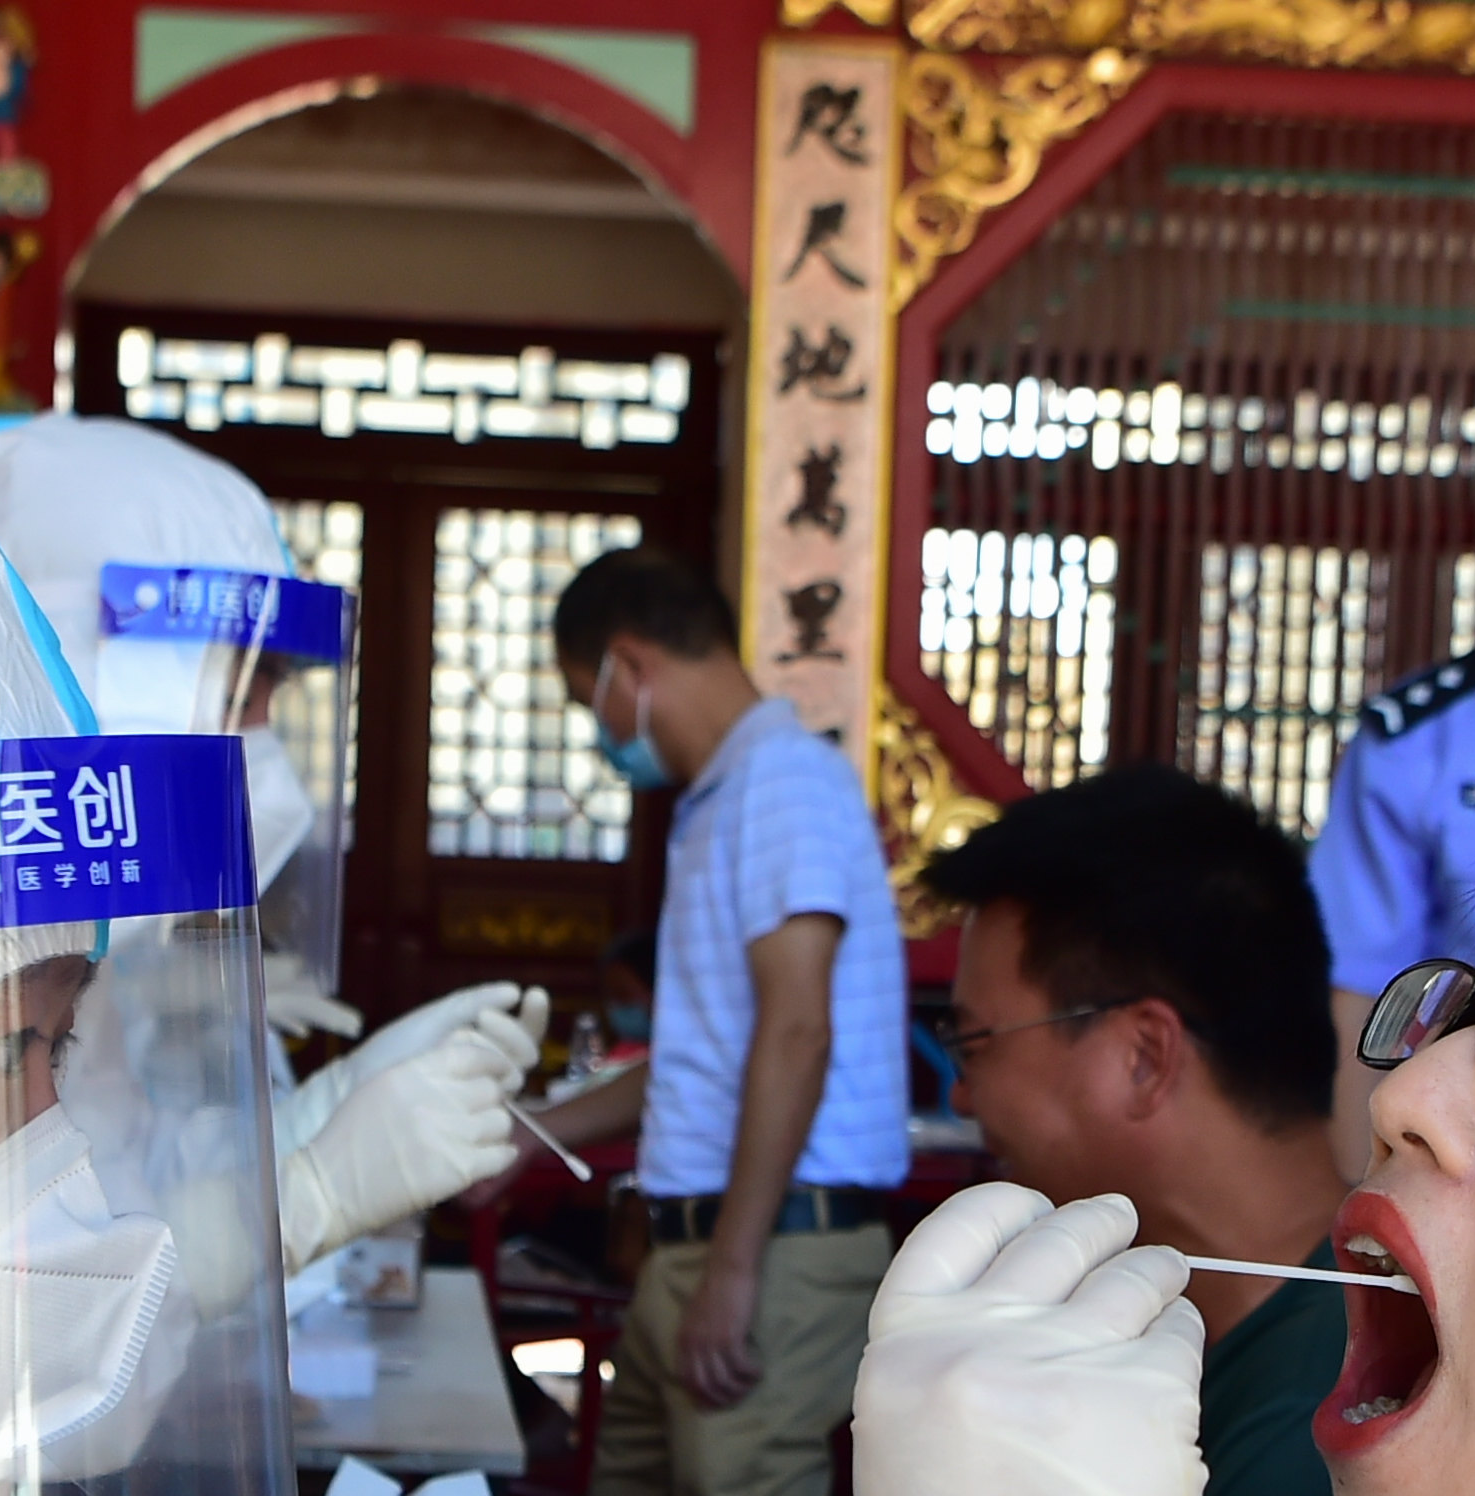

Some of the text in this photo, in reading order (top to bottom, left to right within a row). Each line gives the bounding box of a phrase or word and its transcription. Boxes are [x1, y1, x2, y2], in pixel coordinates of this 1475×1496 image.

[775, 82, 872, 744] 咫尺地萬里
